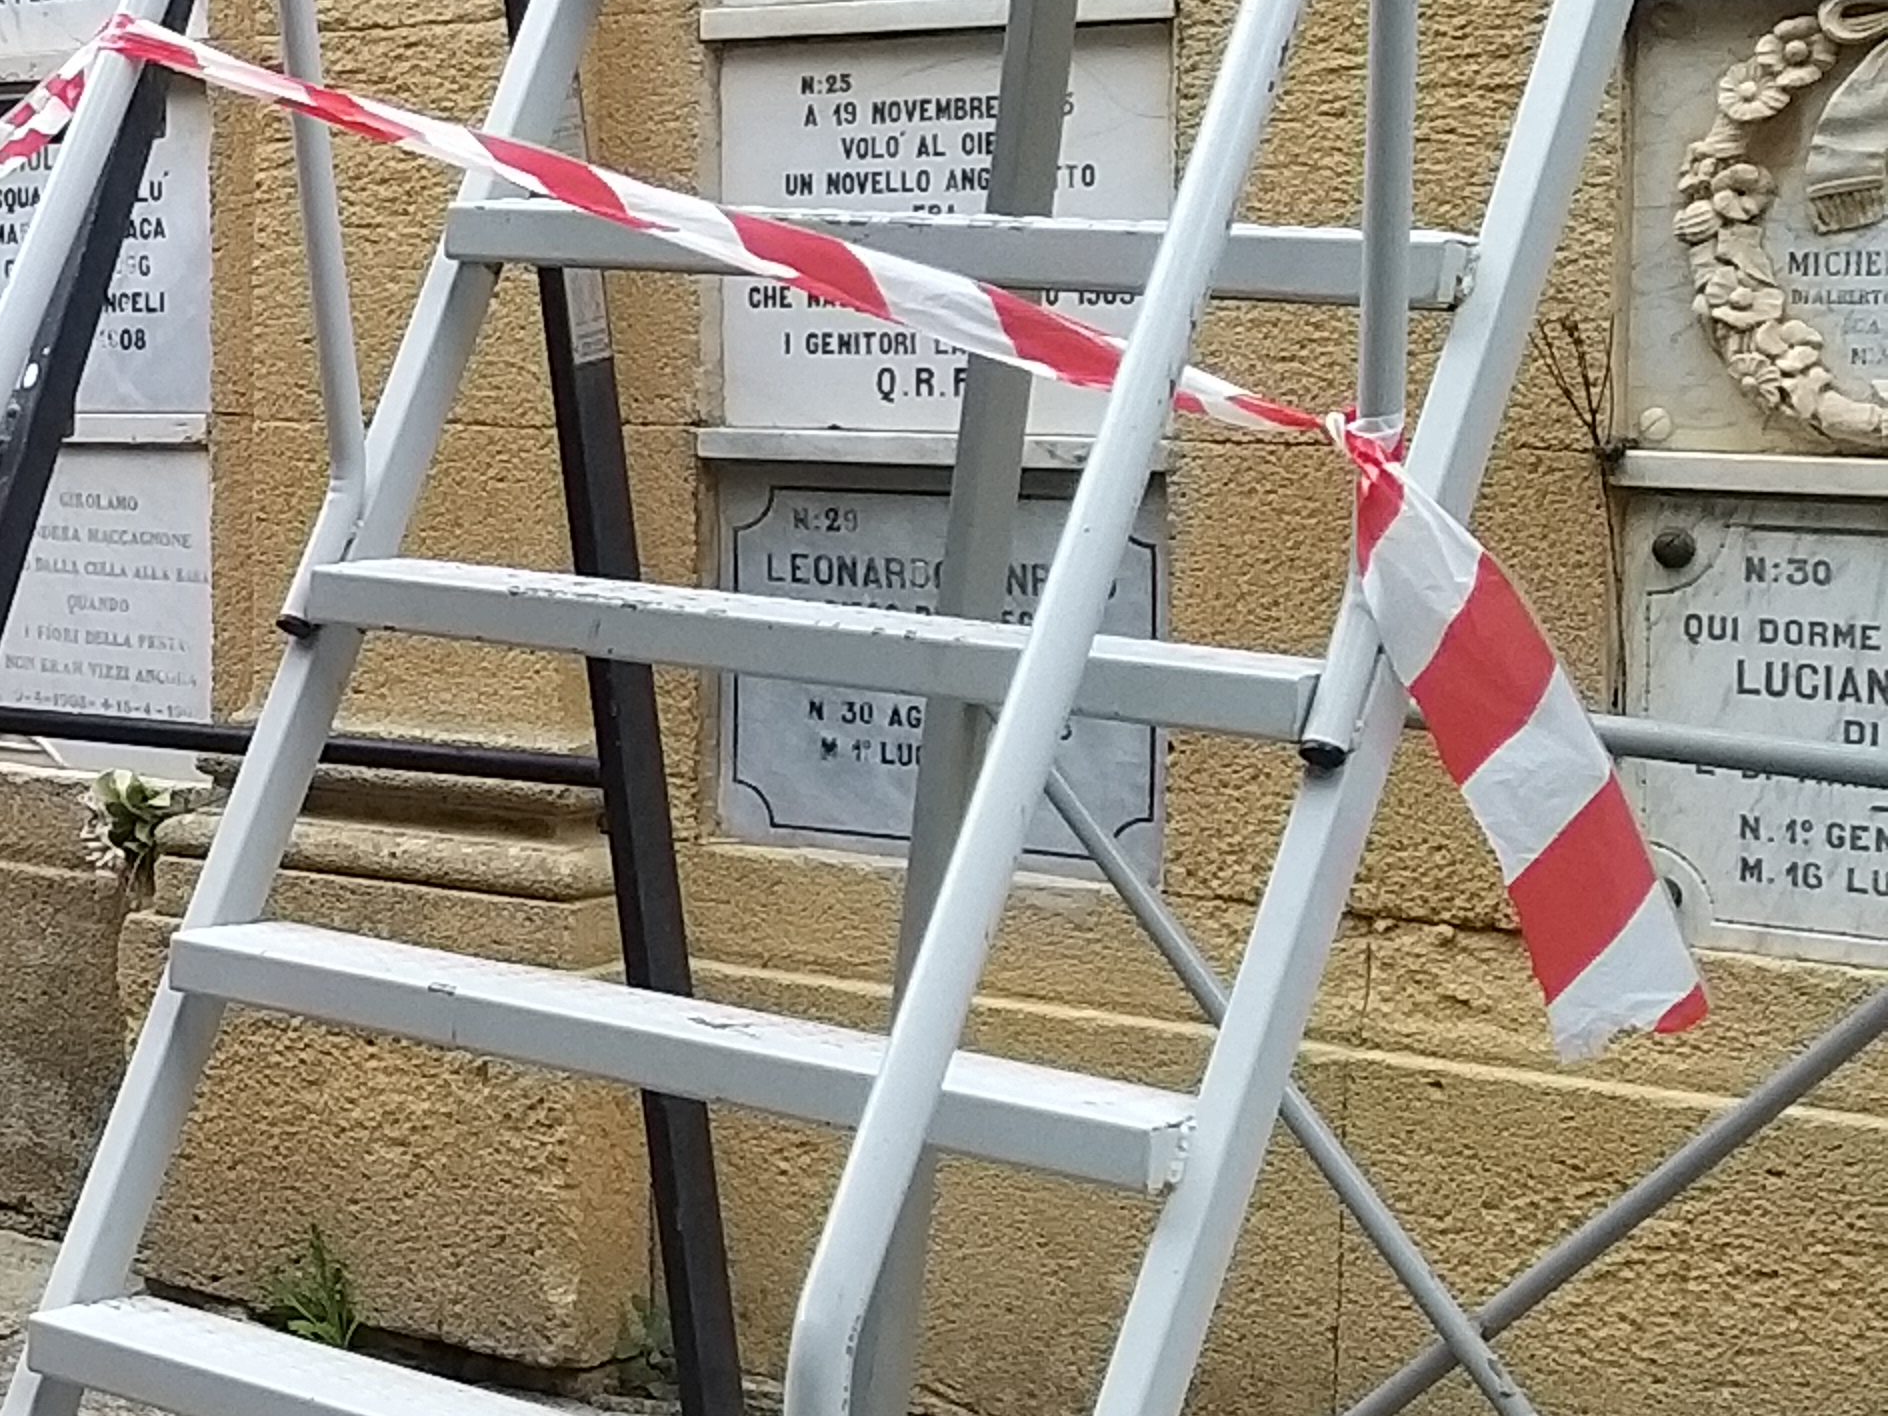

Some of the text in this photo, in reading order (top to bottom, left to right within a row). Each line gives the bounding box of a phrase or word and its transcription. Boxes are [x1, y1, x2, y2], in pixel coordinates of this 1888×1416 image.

[804, 97, 997, 127] A 19 NOVEMBRE
[916, 136, 946, 157] AL
[786, 170, 931, 194] UN NOVELLO
[749, 286, 791, 308] CHE
[805, 331, 916, 354] GENITORI
[1684, 613, 1881, 651] QUI DORME
[842, 702, 873, 723] 30
[1843, 719, 1879, 745] DI
